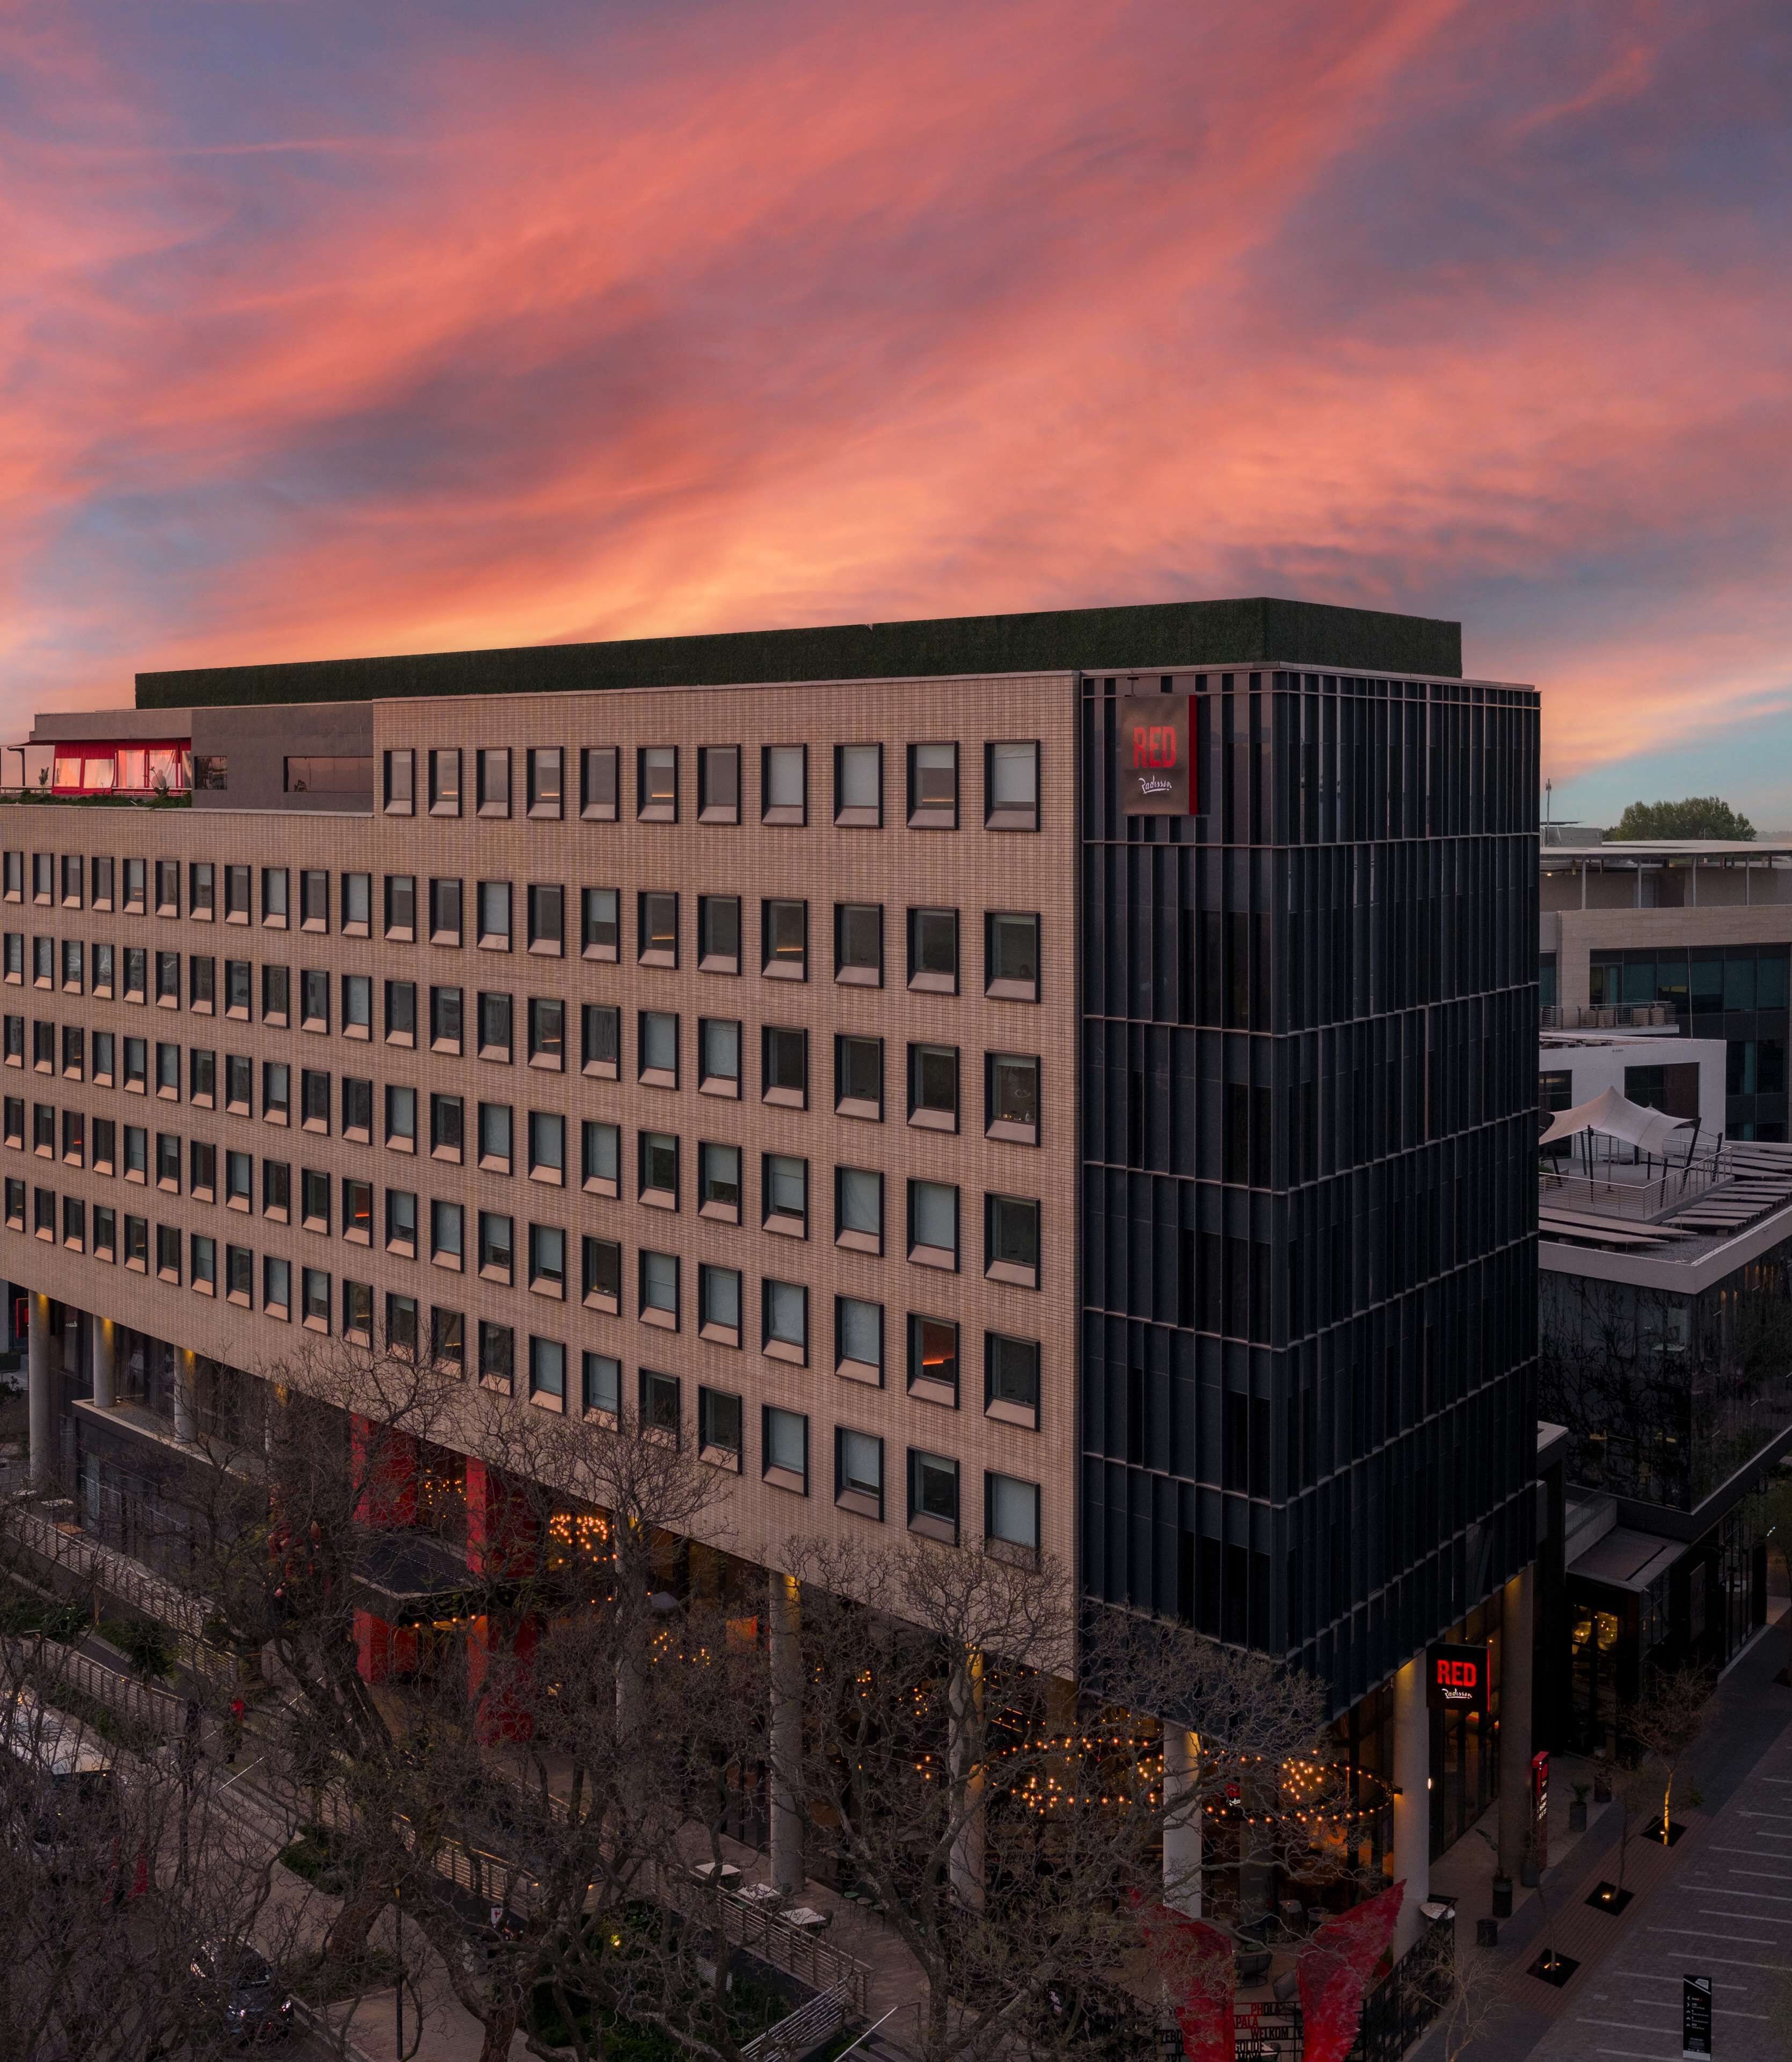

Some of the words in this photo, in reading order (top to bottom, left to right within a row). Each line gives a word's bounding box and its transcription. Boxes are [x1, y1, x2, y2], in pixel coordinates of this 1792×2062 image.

[1133, 726, 1177, 768] RED
[1138, 774, 1172, 795] Radisson
[1437, 1659, 1477, 1687] RED
[1441, 1688, 1473, 1699] Radisson
[1251, 2027, 1289, 2040] WELKOM
